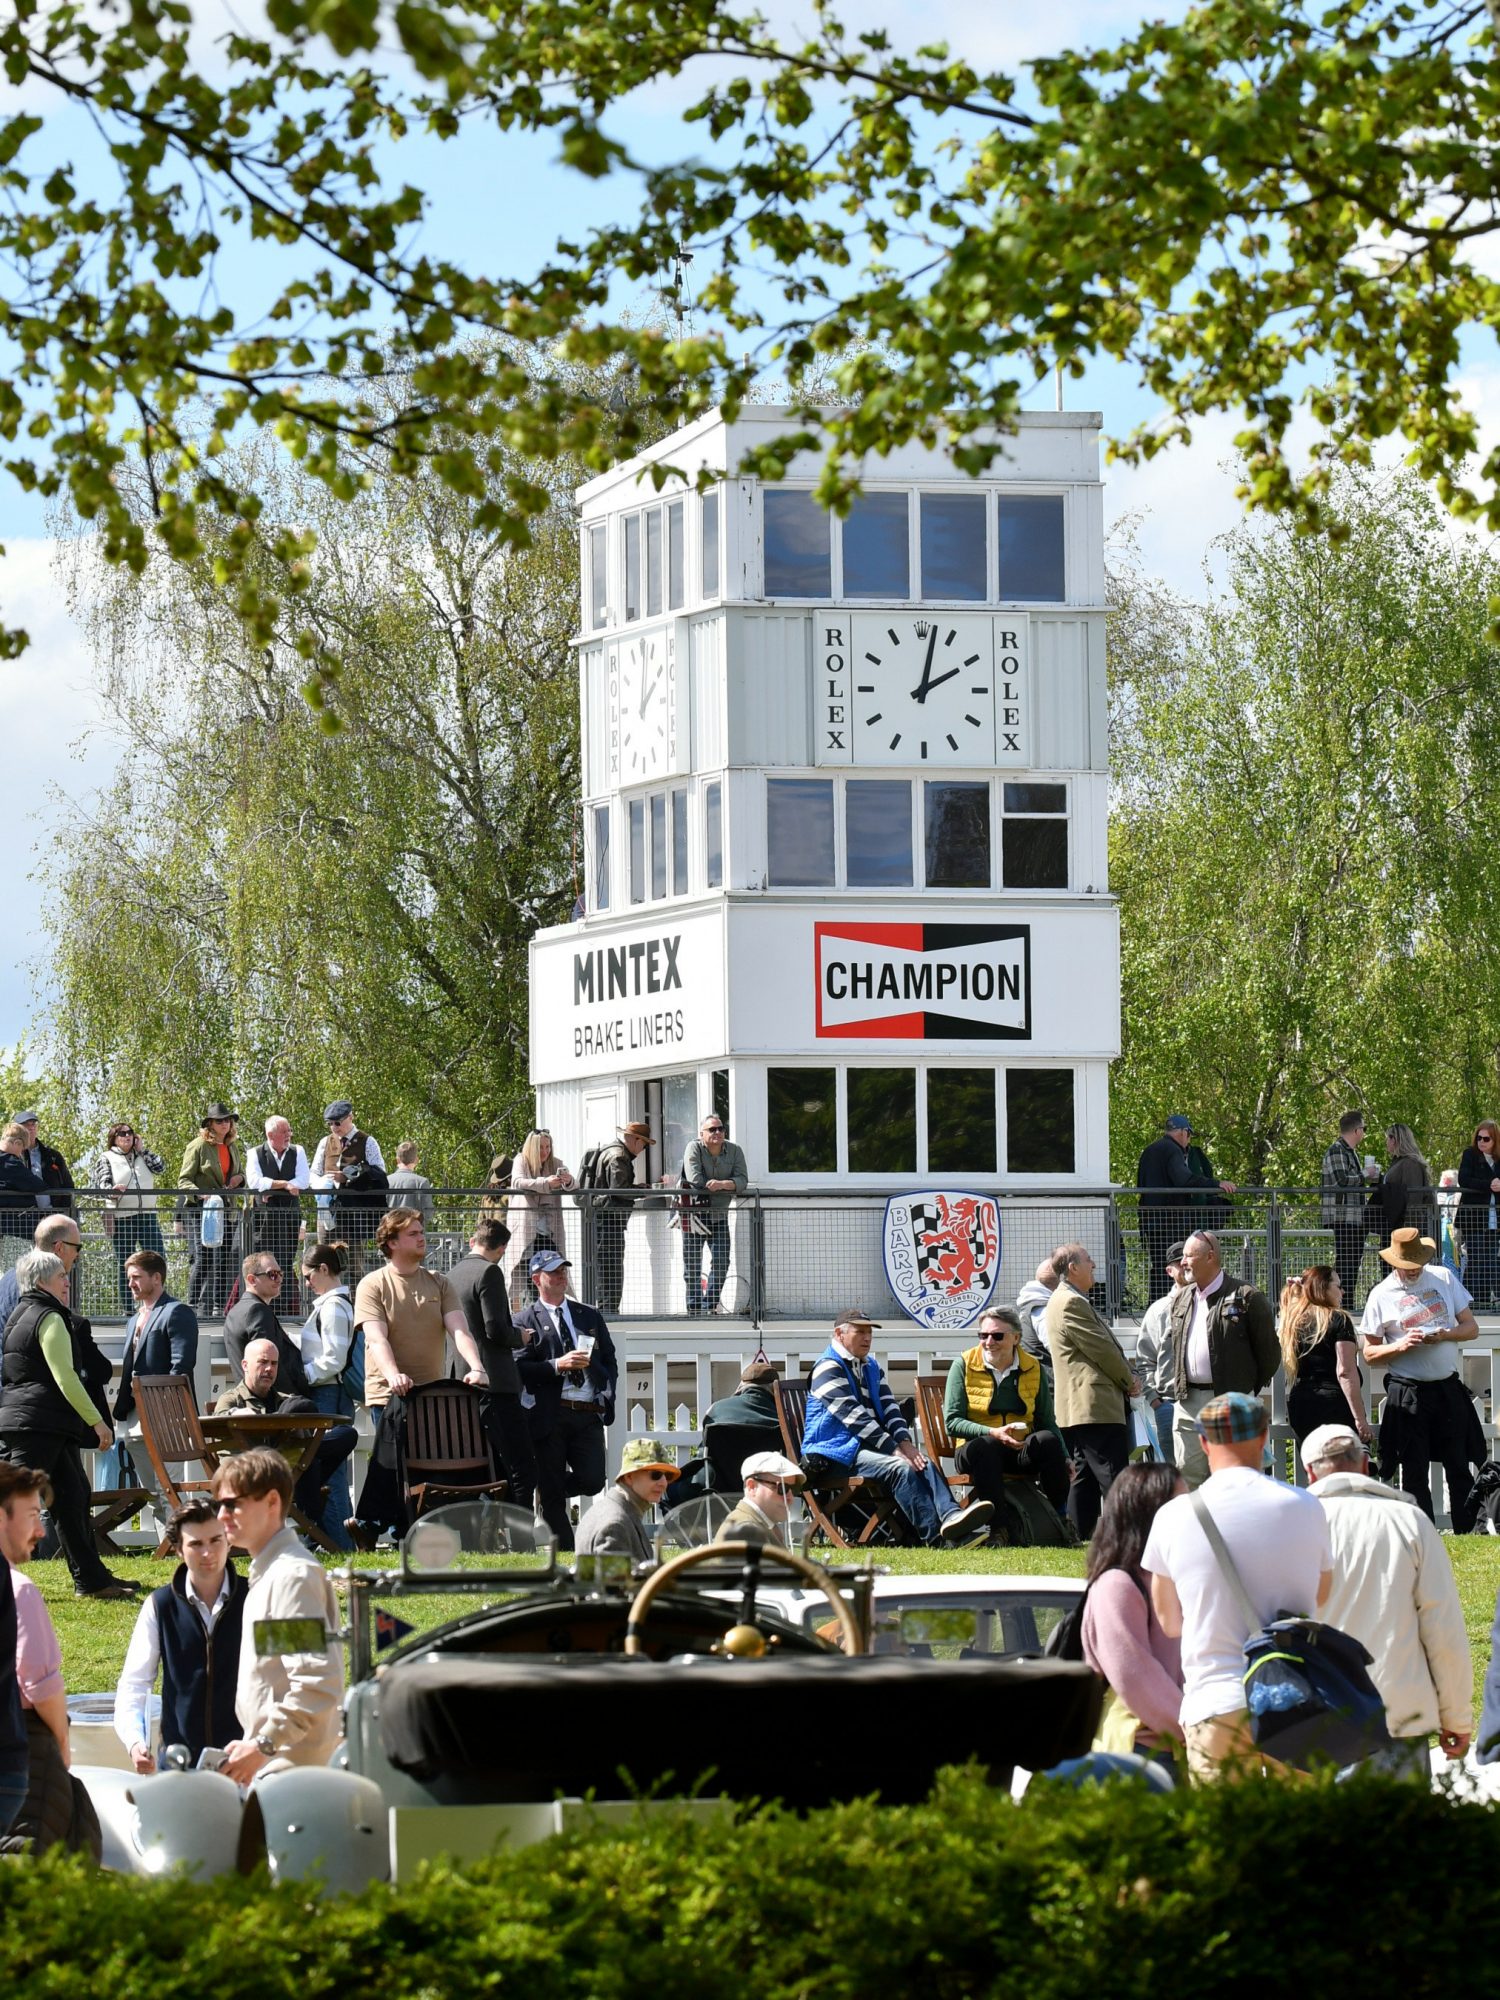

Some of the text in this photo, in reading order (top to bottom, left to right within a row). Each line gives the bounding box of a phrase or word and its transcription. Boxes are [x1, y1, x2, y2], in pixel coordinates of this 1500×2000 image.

[609, 655, 619, 773] ROLEX
[825, 628, 845, 749] ROLEX
[1000, 631, 1021, 751] ROLEX
[574, 935, 682, 1006] MINTEX
[826, 961, 1020, 1001] CHAMPION
[574, 1009, 684, 1058] BRAKE LINERS
[890, 1207, 914, 1292] BARC
[912, 1294, 981, 1310] BRITISH AUTOMOBILE
[939, 1309, 965, 1318] RACING
[637, 1381, 649, 1391] 19
